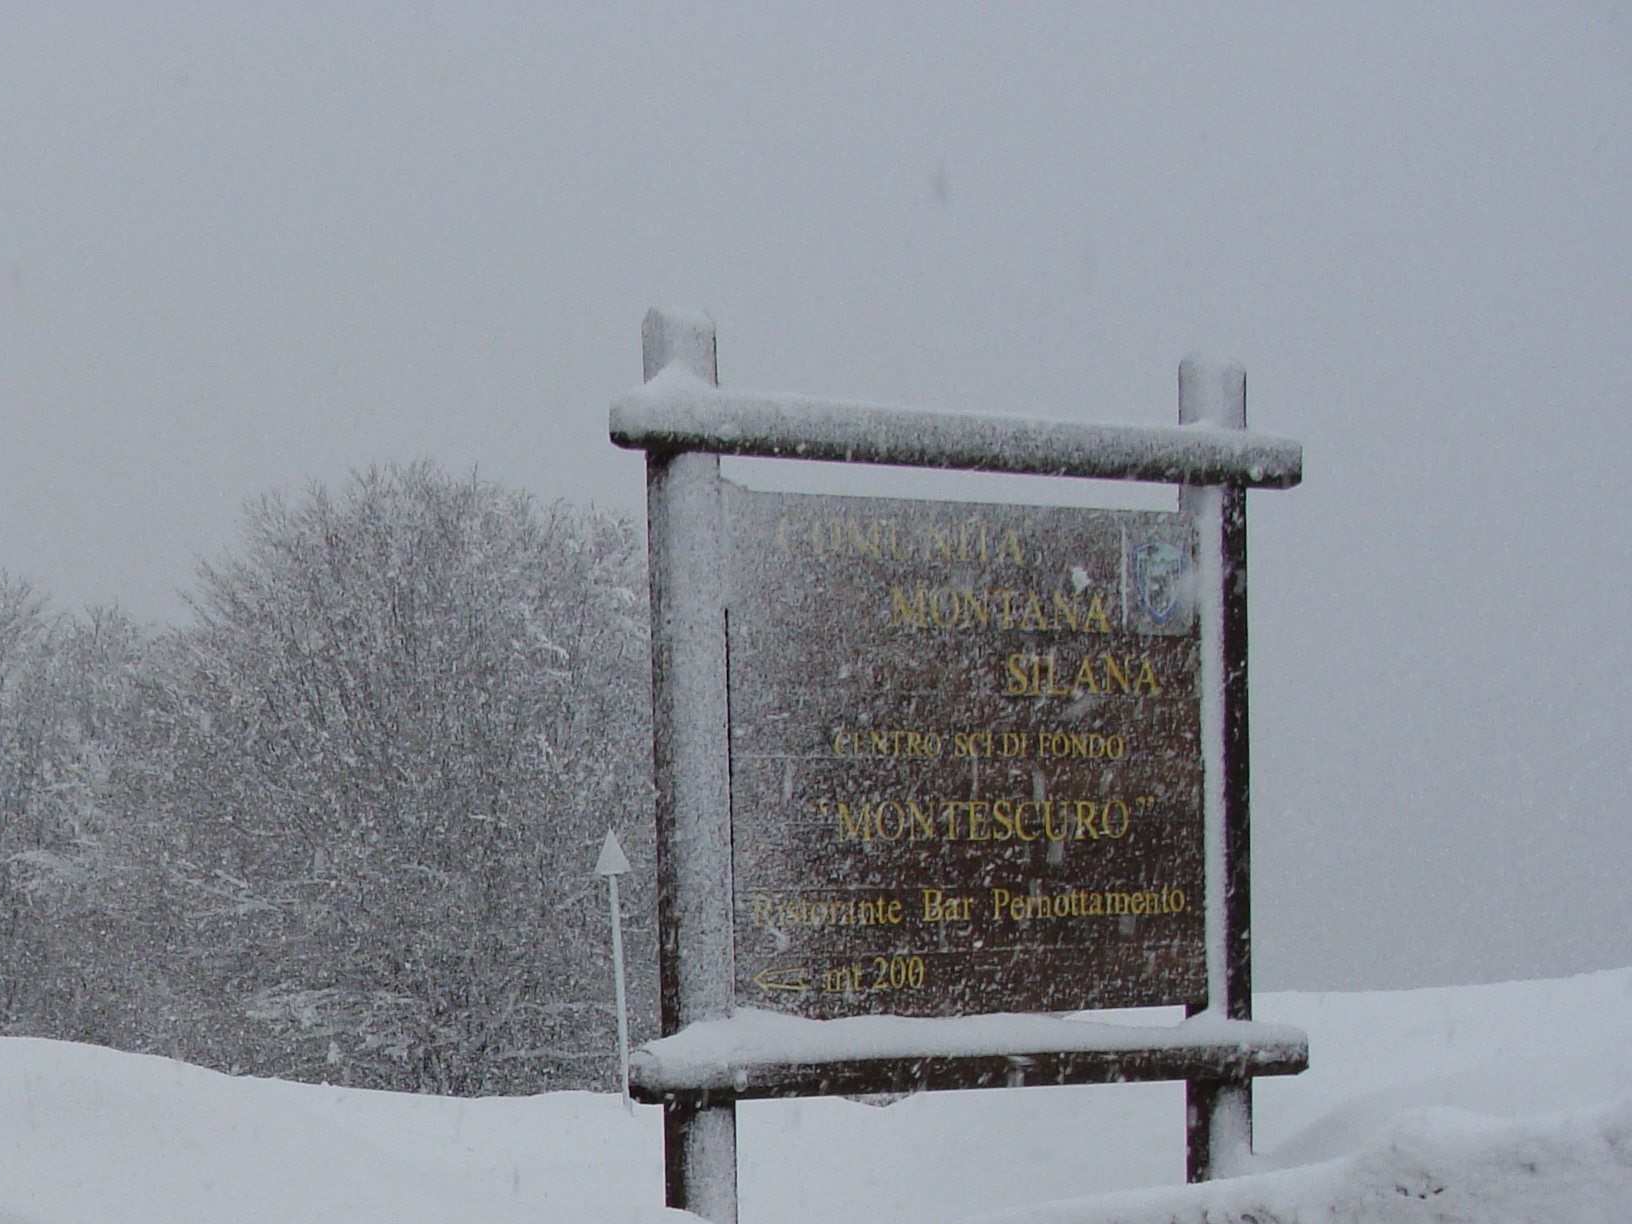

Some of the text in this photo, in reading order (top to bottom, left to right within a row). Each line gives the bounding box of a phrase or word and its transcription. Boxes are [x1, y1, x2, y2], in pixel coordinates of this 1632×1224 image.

[890, 585, 1112, 633] MONTANA
[1006, 651, 1160, 697] SILANA
[833, 730, 1125, 761] CENTRO SCI DI FONDO
[749, 892, 903, 928] Ristorante
[920, 888, 974, 922] Bar
[826, 955, 926, 992] mt 200
